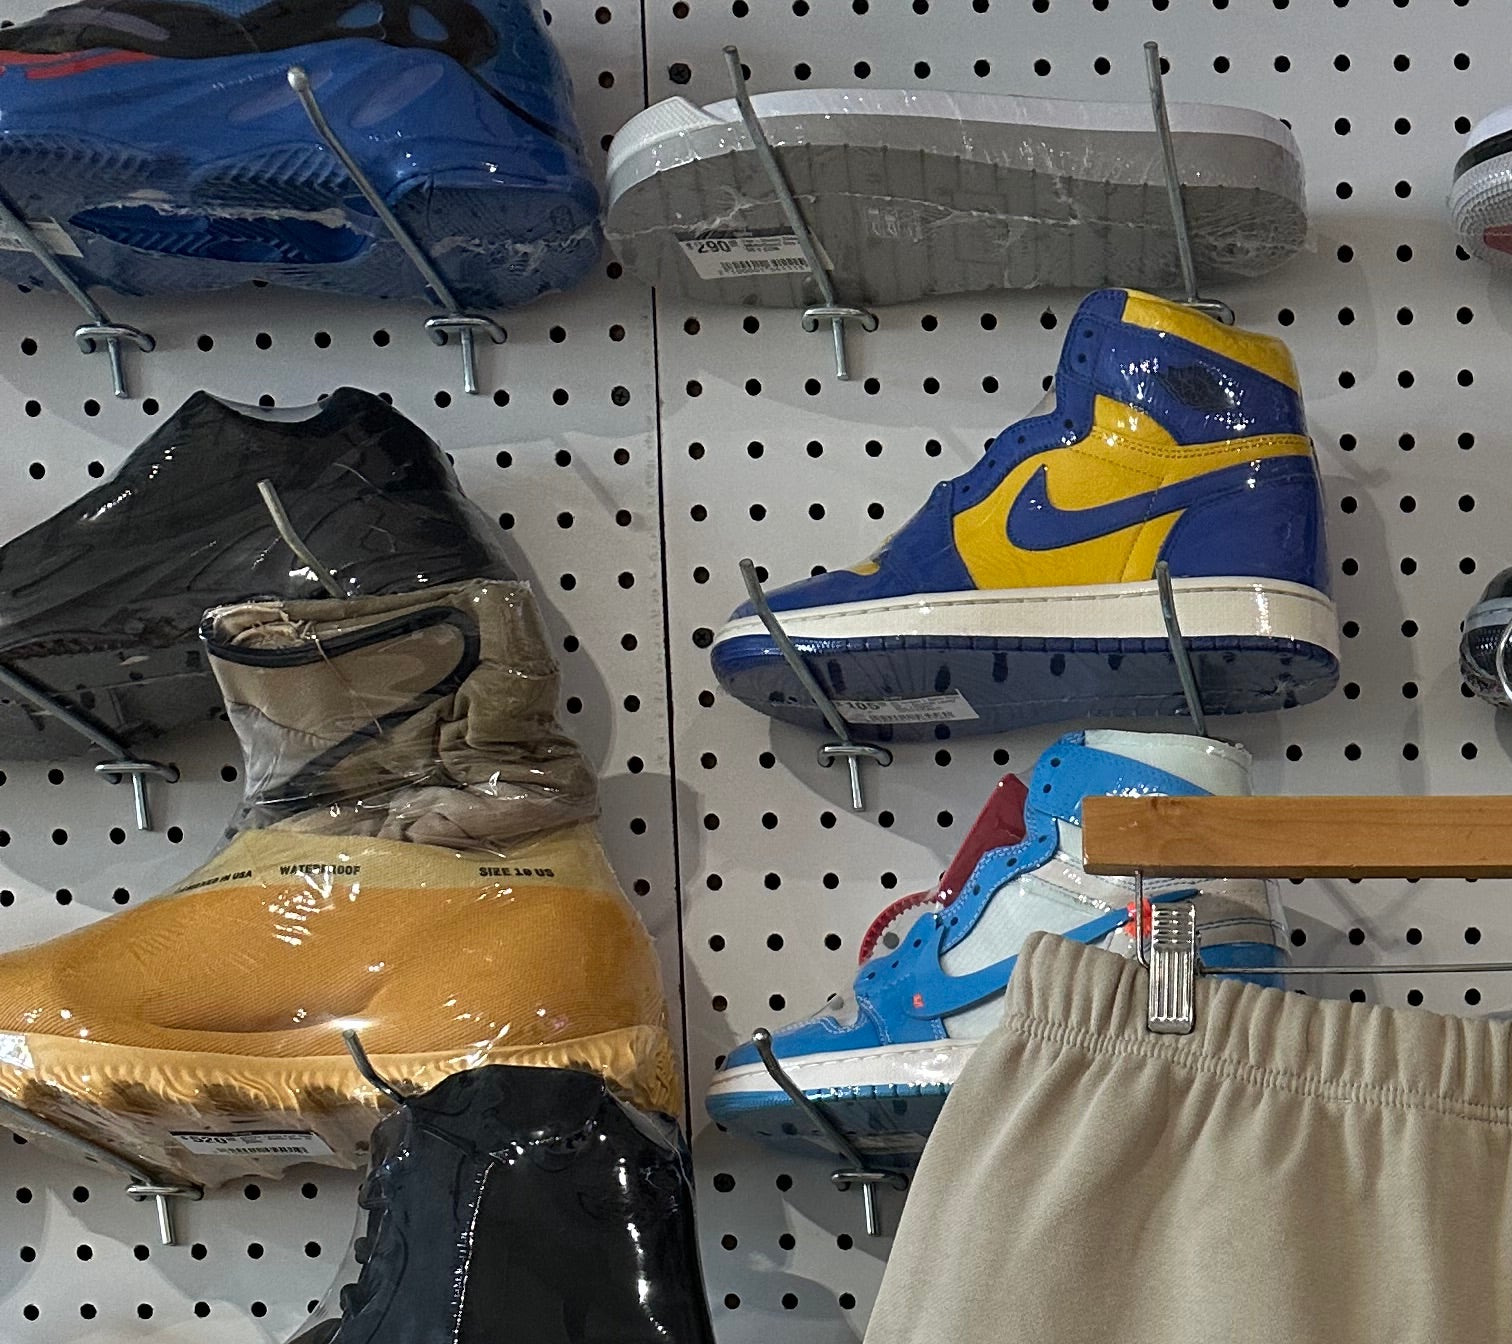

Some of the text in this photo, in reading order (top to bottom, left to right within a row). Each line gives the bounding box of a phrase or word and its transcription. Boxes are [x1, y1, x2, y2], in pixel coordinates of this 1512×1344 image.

[232, 870, 252, 880] USA
[479, 867, 511, 876] SIZE
[533, 868, 555, 878] US
